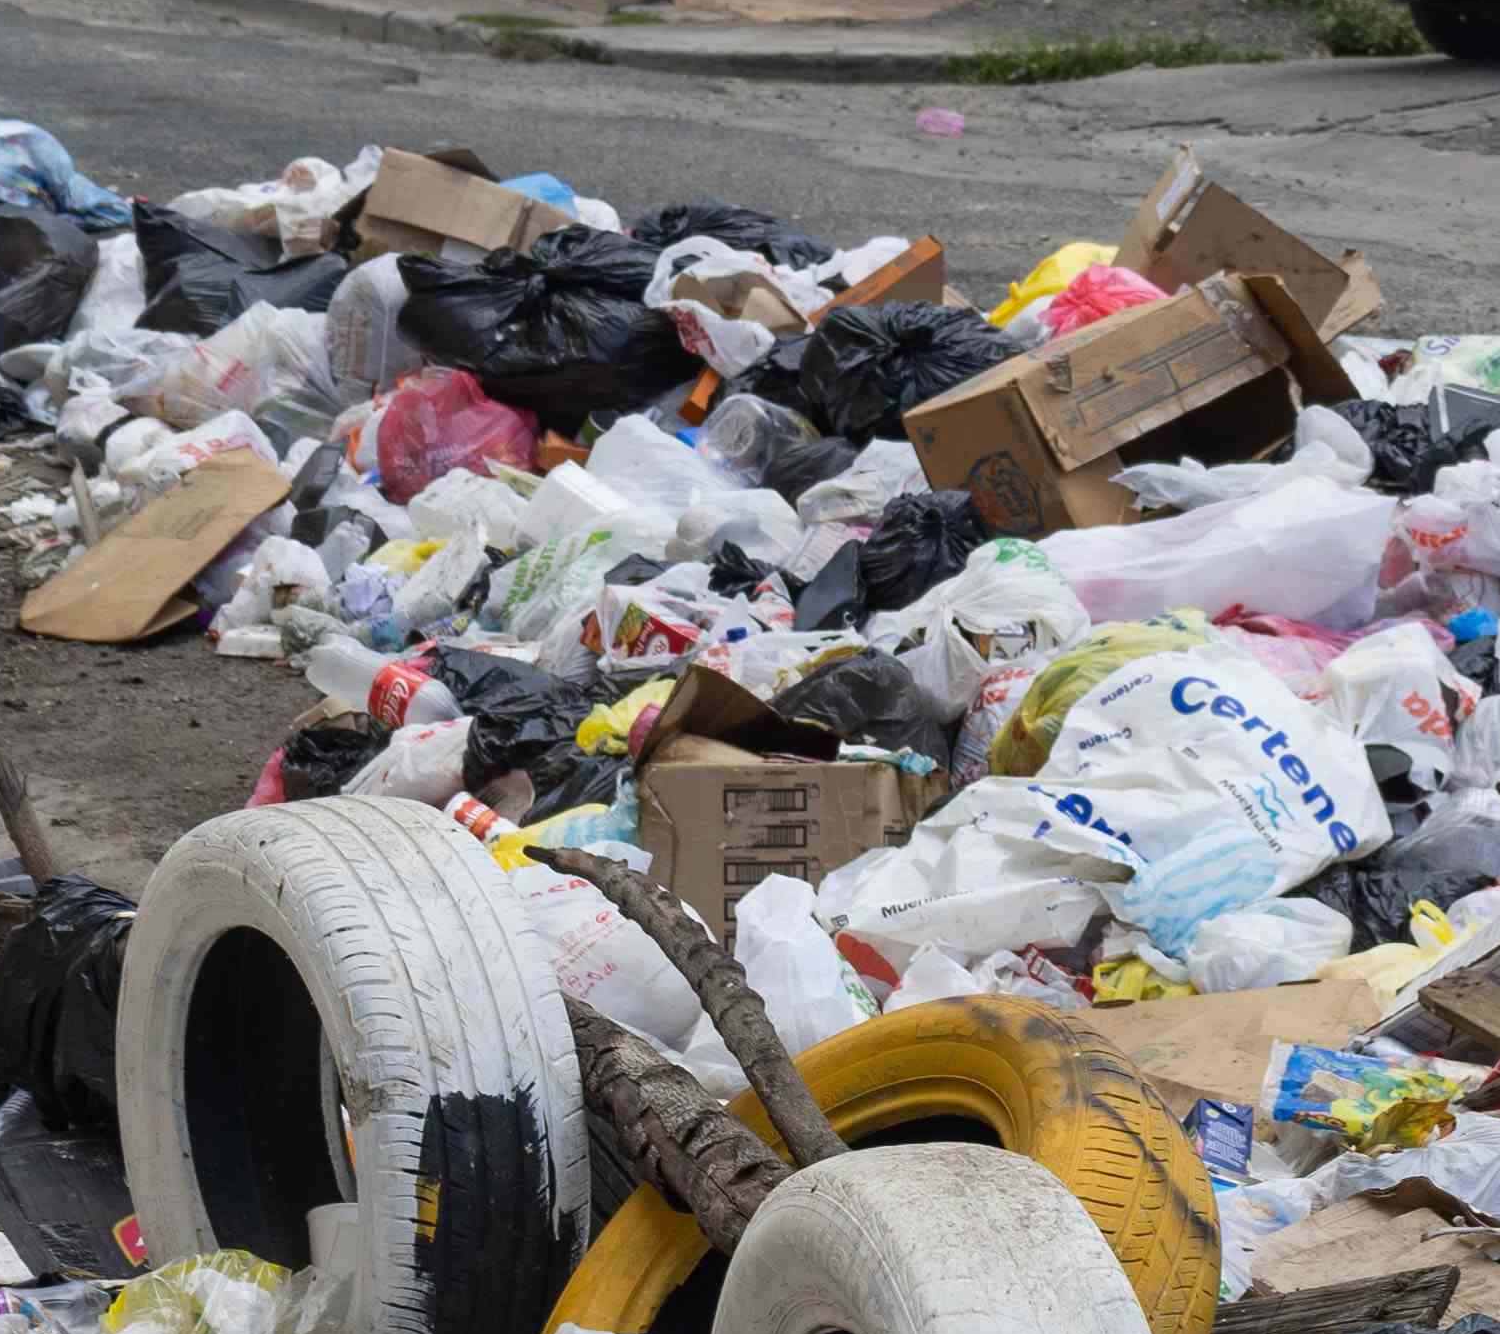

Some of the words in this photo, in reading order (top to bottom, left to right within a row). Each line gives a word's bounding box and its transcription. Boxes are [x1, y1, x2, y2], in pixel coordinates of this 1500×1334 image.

[1100, 674, 1153, 707] Certene
[1169, 675, 1360, 855] Certene
[1219, 778, 1286, 855] Muehlstein
